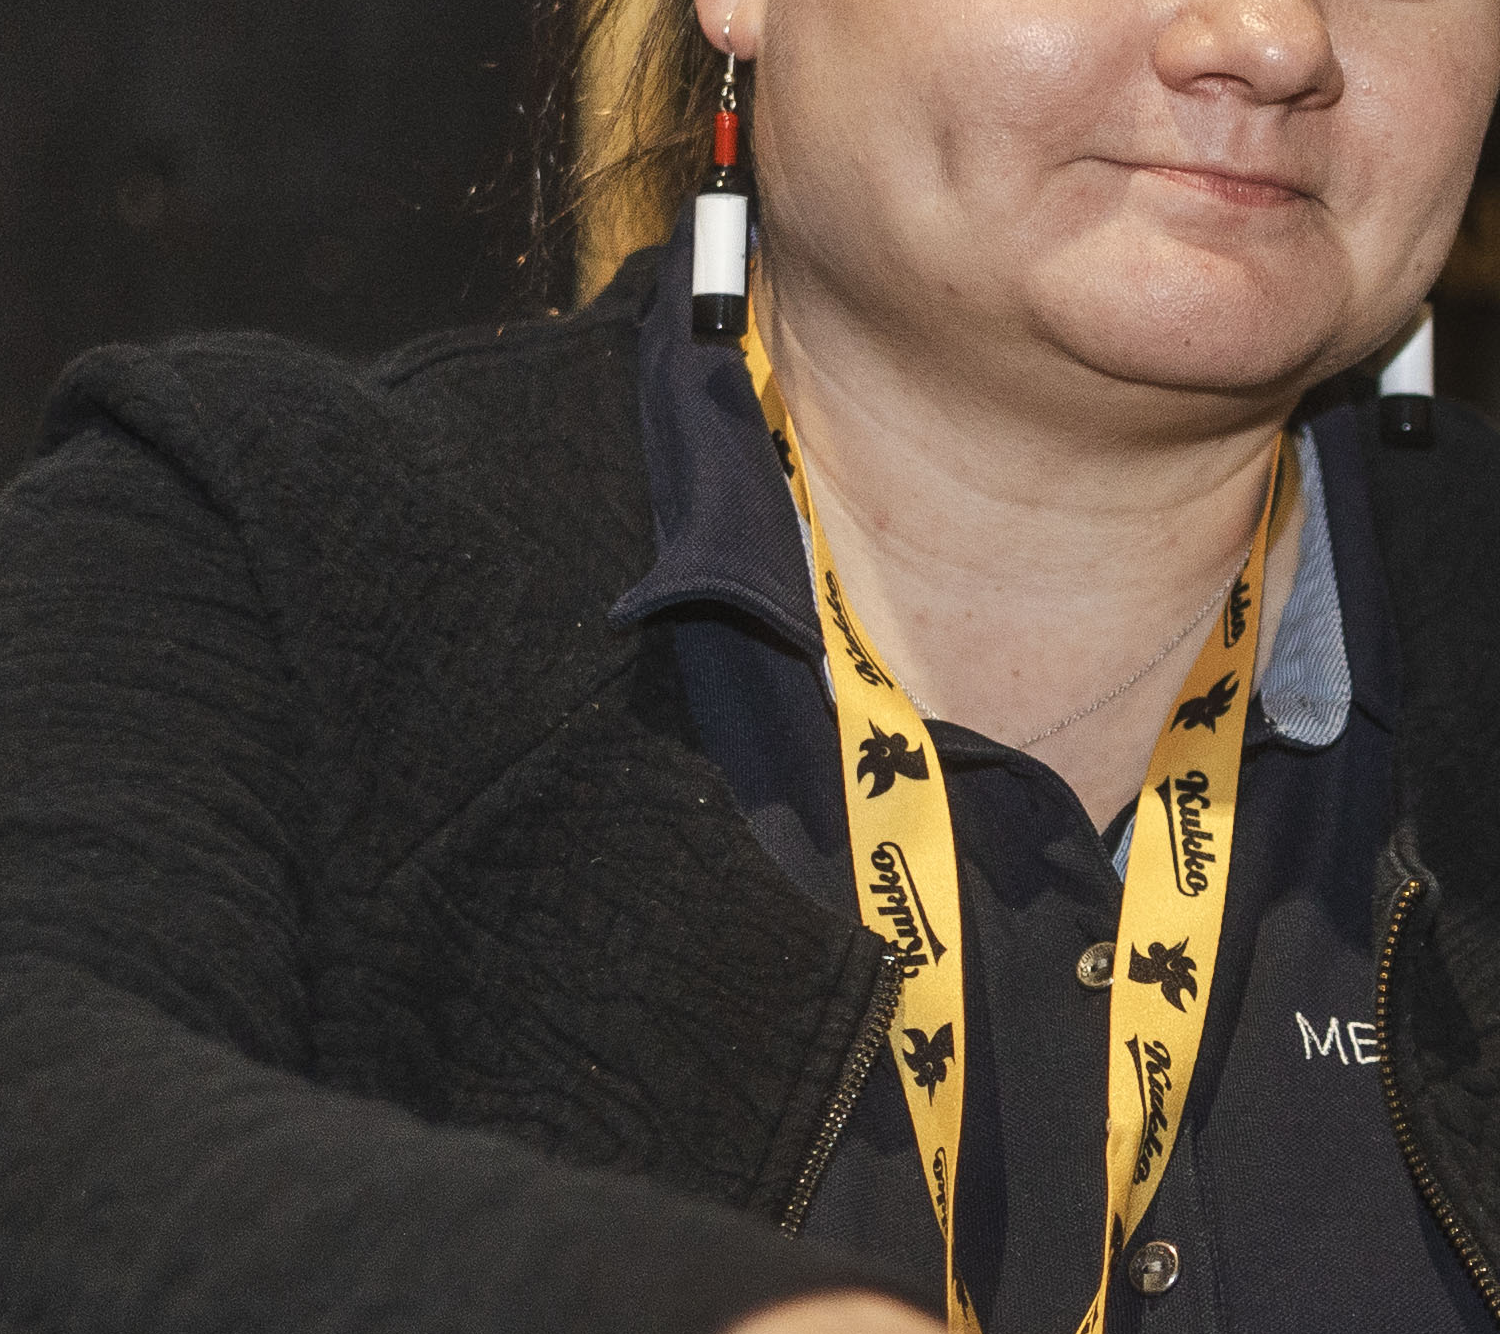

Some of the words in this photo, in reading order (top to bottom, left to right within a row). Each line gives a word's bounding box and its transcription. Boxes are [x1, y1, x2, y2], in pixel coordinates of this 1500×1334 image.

[1162, 770, 1216, 897] Kukko
[869, 841, 940, 979] Kukko
[1127, 1037, 1172, 1185] Kukko
